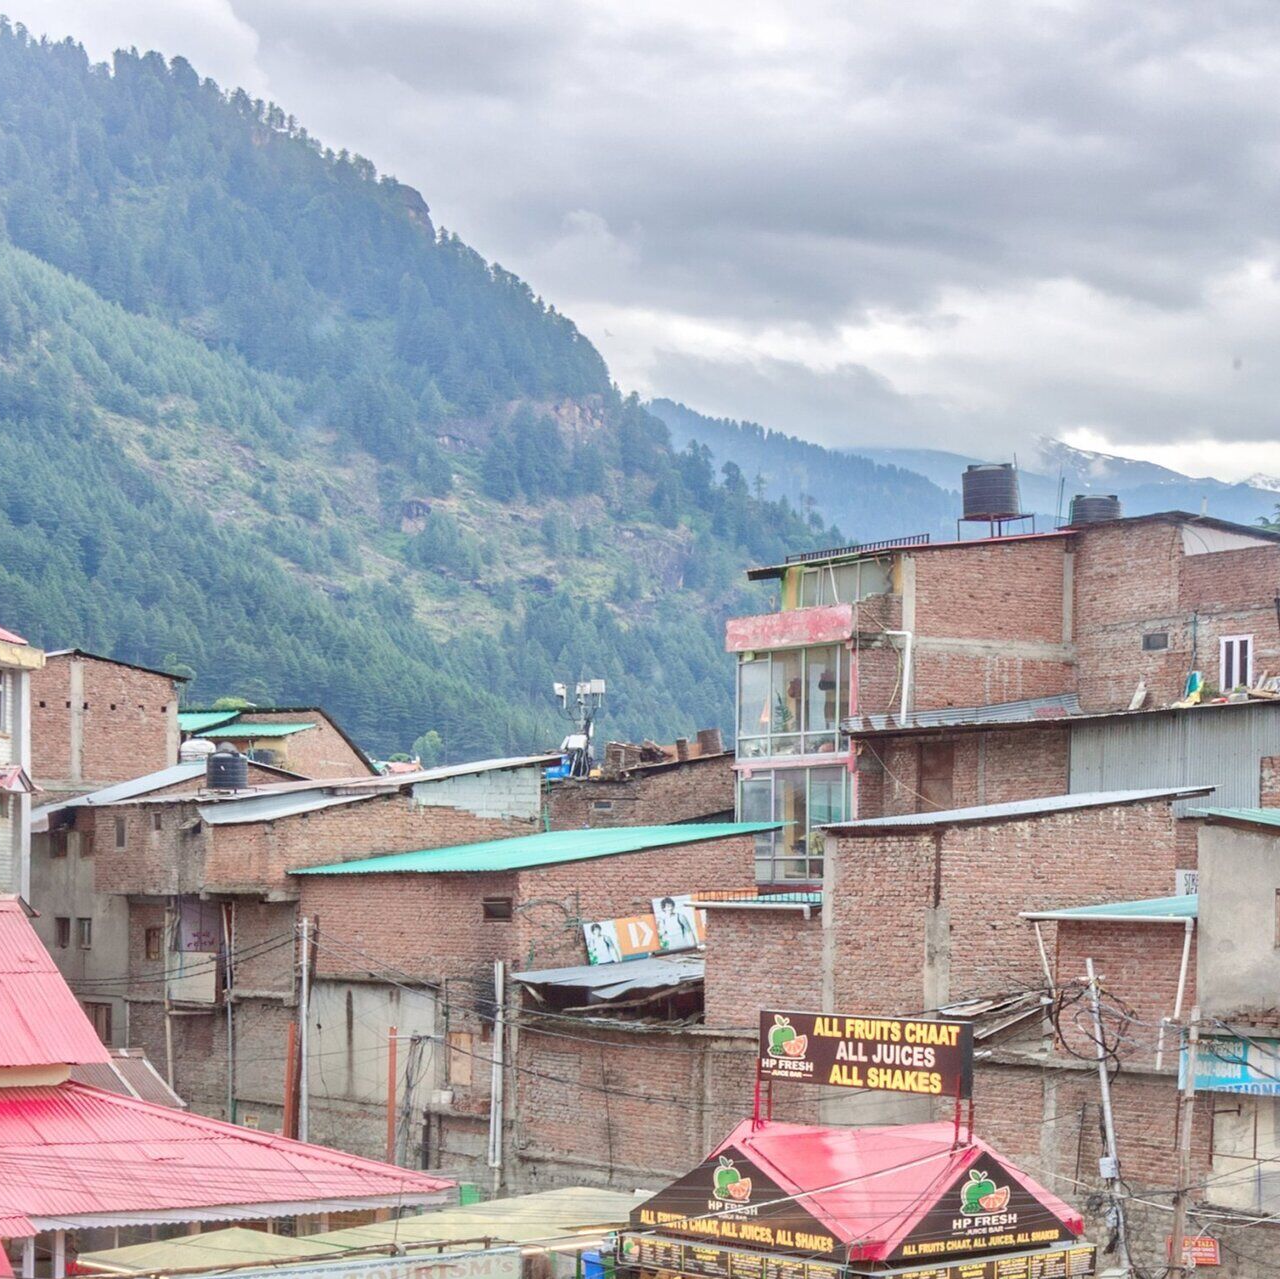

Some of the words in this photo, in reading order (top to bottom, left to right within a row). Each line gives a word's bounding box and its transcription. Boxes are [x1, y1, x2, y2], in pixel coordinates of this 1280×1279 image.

[813, 1017, 842, 1037] ALL
[845, 1019, 901, 1042] FRUITS
[904, 1022, 960, 1046] CHAAT
[836, 1041, 868, 1062] ALL
[872, 1044, 936, 1068] JUICES
[761, 1059, 777, 1069] HP
[778, 1059, 814, 1072] FRESH
[771, 1069, 789, 1077] JUICE
[829, 1064, 864, 1086] ALL
[867, 1067, 942, 1094] SHAKES
[708, 1200, 723, 1210] HP
[640, 1210, 655, 1224] ALL
[689, 1219, 720, 1237] CHAAT,
[722, 1222, 737, 1237] ALL
[740, 1224, 774, 1246] JUICES,
[776, 1230, 793, 1246] ALL
[795, 1235, 834, 1253] SHAKES
[952, 1218, 972, 1229] HP
[974, 1213, 1018, 1227] FRESH
[965, 1227, 987, 1235] JUICE
[988, 1225, 1004, 1233] BAR
[902, 1244, 917, 1256] ALL
[918, 1241, 945, 1254] FRUITS
[947, 1239, 973, 1251] CHAAT,
[974, 1238, 987, 1248] ALL
[988, 1234, 1016, 1247] JUICES,
[1017, 1232, 1030, 1244] ALL
[1031, 1229, 1059, 1242] SHAKES
